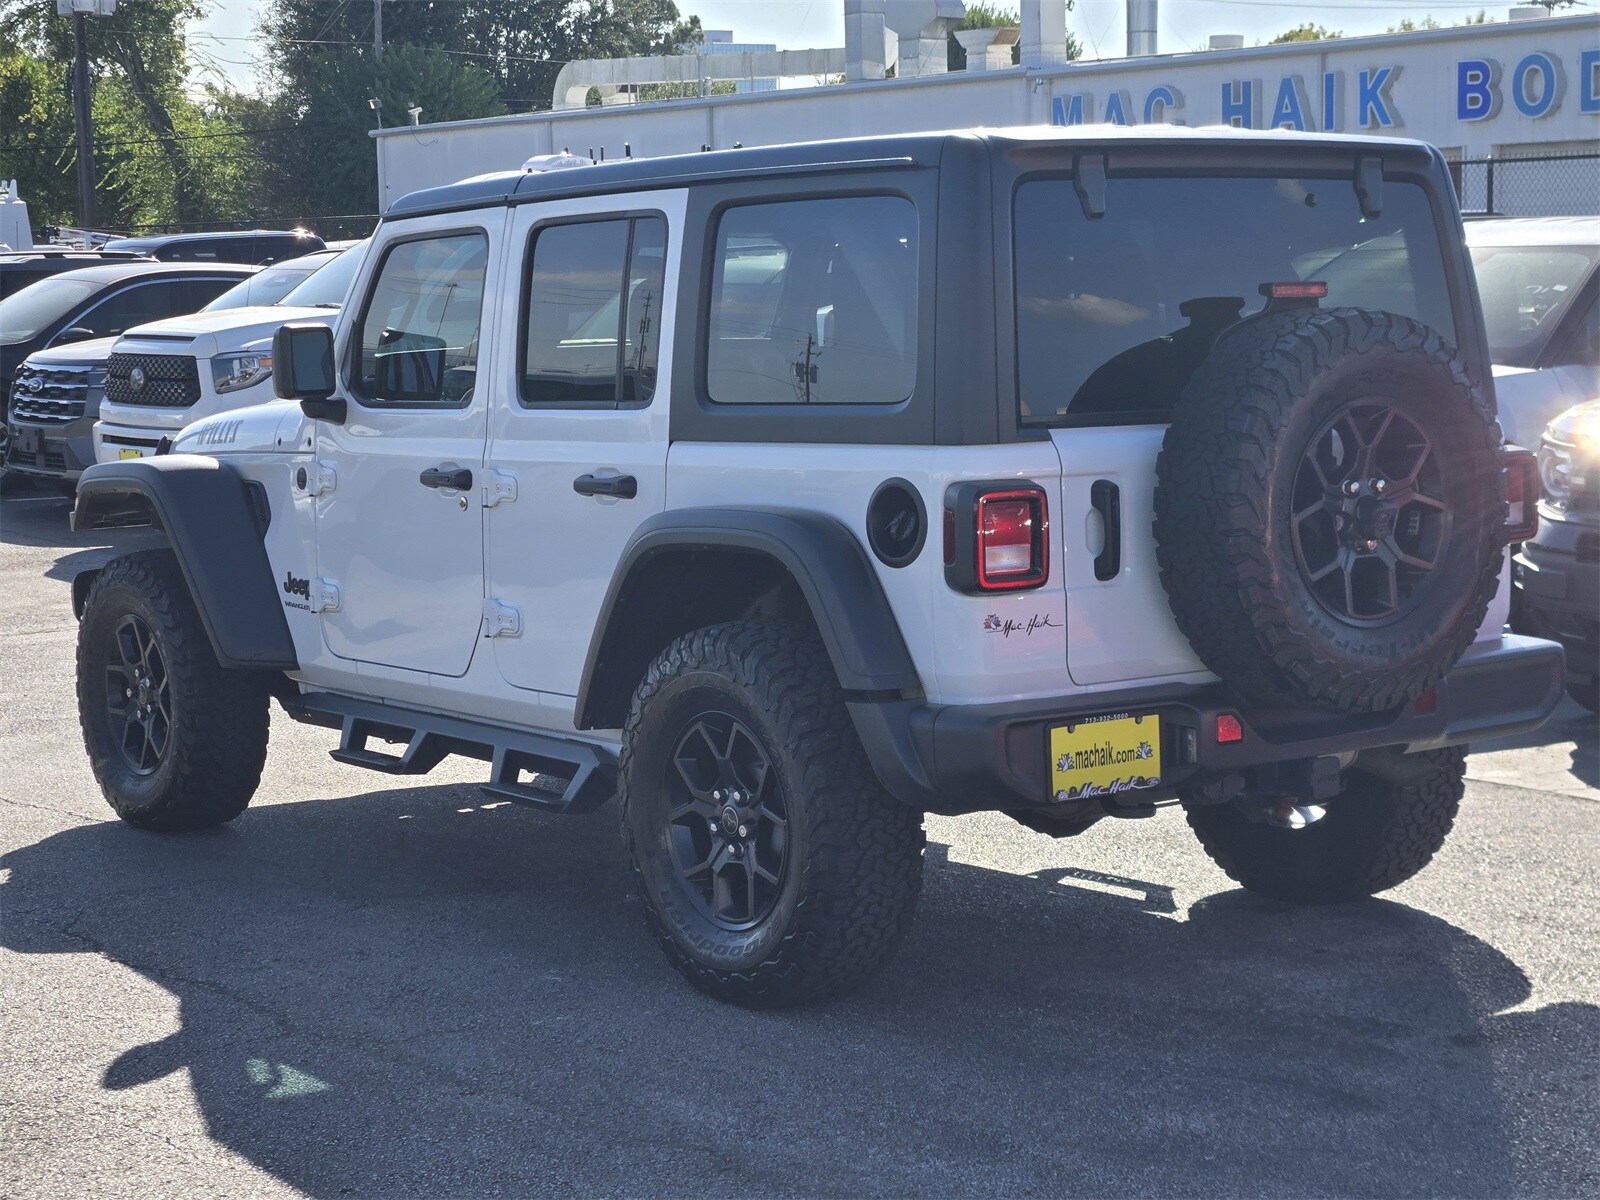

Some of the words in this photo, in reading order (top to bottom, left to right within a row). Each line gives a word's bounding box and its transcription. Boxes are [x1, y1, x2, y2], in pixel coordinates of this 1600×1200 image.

[1051, 86, 1175, 127] MAC
[1221, 66, 1394, 132] HAIK
[196, 419, 245, 446] WILLYS
[283, 571, 310, 601] Jeep
[284, 600, 311, 611] WRANGLER
[1001, 618, 1025, 639] Mac
[1025, 613, 1063, 637] Haik
[1075, 740, 1136, 770] machaik.com
[1080, 782, 1109, 799] Mac
[1109, 775, 1143, 795] Haik
